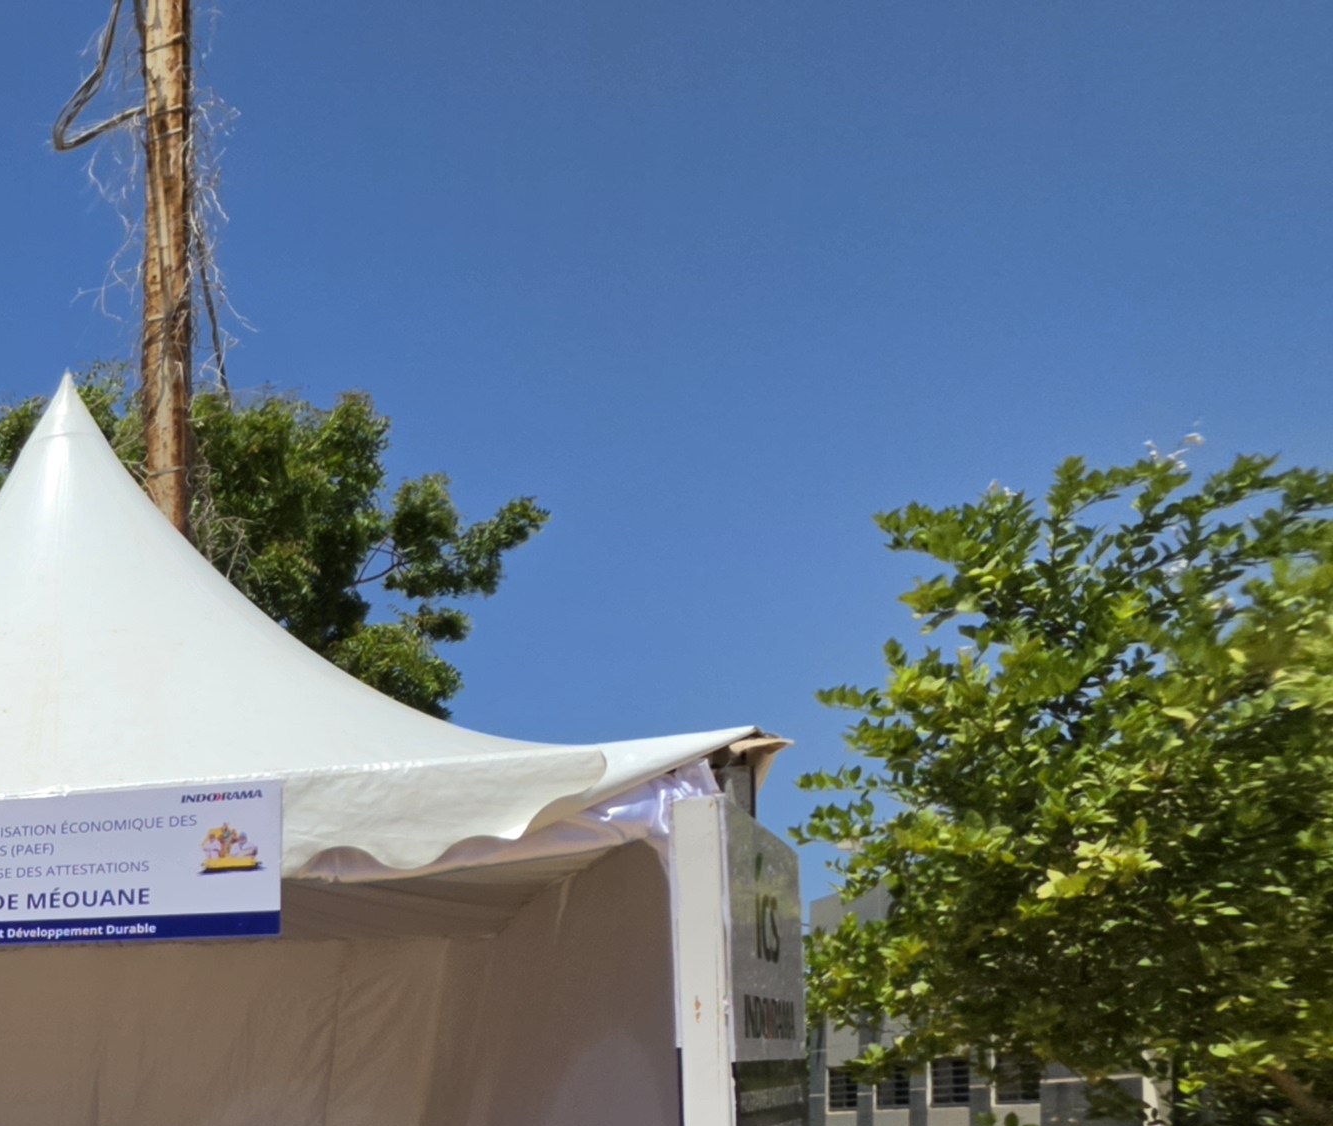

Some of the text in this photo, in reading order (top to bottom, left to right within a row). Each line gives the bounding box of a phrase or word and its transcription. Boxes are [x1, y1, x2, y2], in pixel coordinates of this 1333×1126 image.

[61, 816, 164, 835] ÉCONOMIQUE
[169, 814, 198, 827] DES
[10, 843, 55, 858] (PAEF)
[16, 866, 42, 878] DES
[46, 861, 150, 877] ATTESTATIONS
[26, 887, 151, 909] MÉOUANE
[7, 925, 103, 940] Développement
[106, 923, 157, 935] Durable
